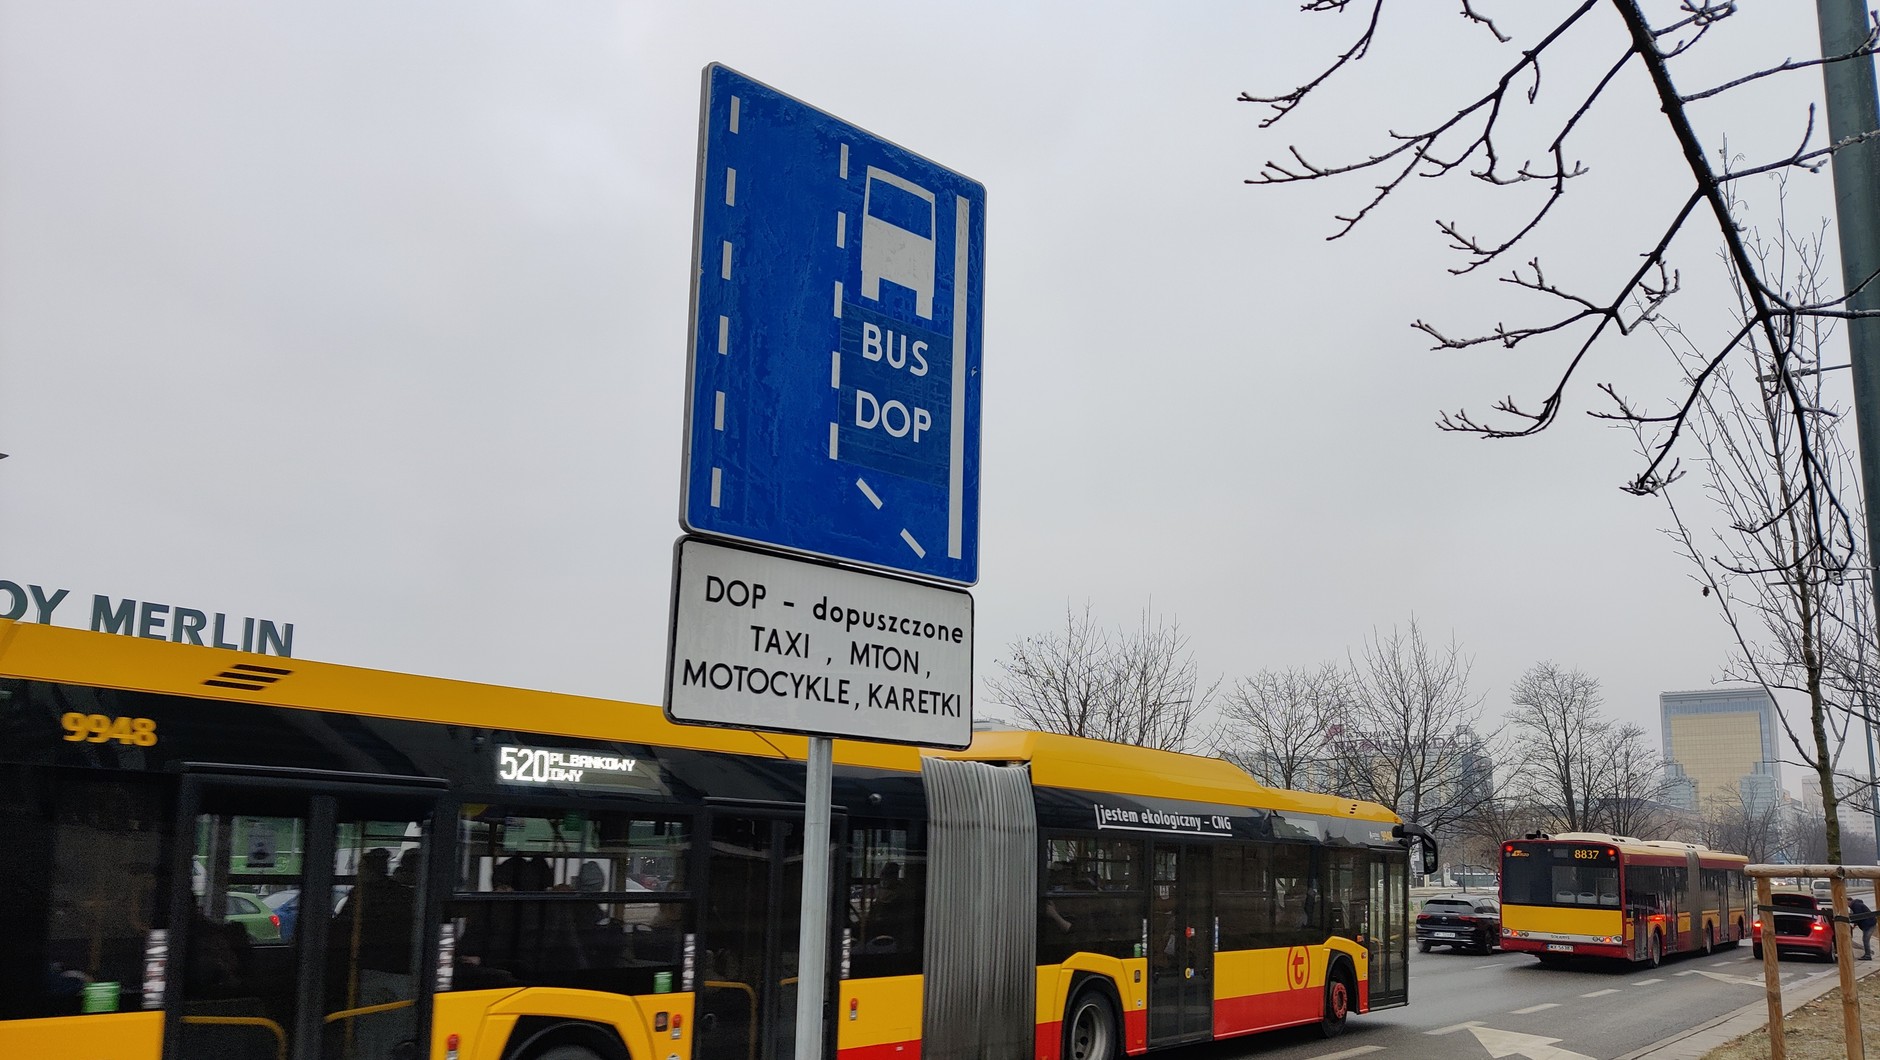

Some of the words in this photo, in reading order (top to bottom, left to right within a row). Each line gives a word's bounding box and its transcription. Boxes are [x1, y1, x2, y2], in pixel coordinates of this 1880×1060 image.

[862, 321, 929, 377] BUS
[856, 389, 932, 443] DOP
[88, 593, 294, 658] MERLIN
[705, 575, 767, 609] DOP
[812, 596, 963, 644] dopuszczone
[750, 625, 810, 659] TAXI
[850, 641, 931, 678] MTON,
[682, 658, 860, 711] MOTOCYKLE,
[868, 682, 962, 718] KARETKI
[61, 712, 158, 747] 9948
[500, 746, 550, 783] 520
[1100, 805, 1139, 824] jestem
[1141, 809, 1201, 831] ekologiczny
[1211, 815, 1232, 830] CNG
[1574, 849, 1599, 860] 8837
